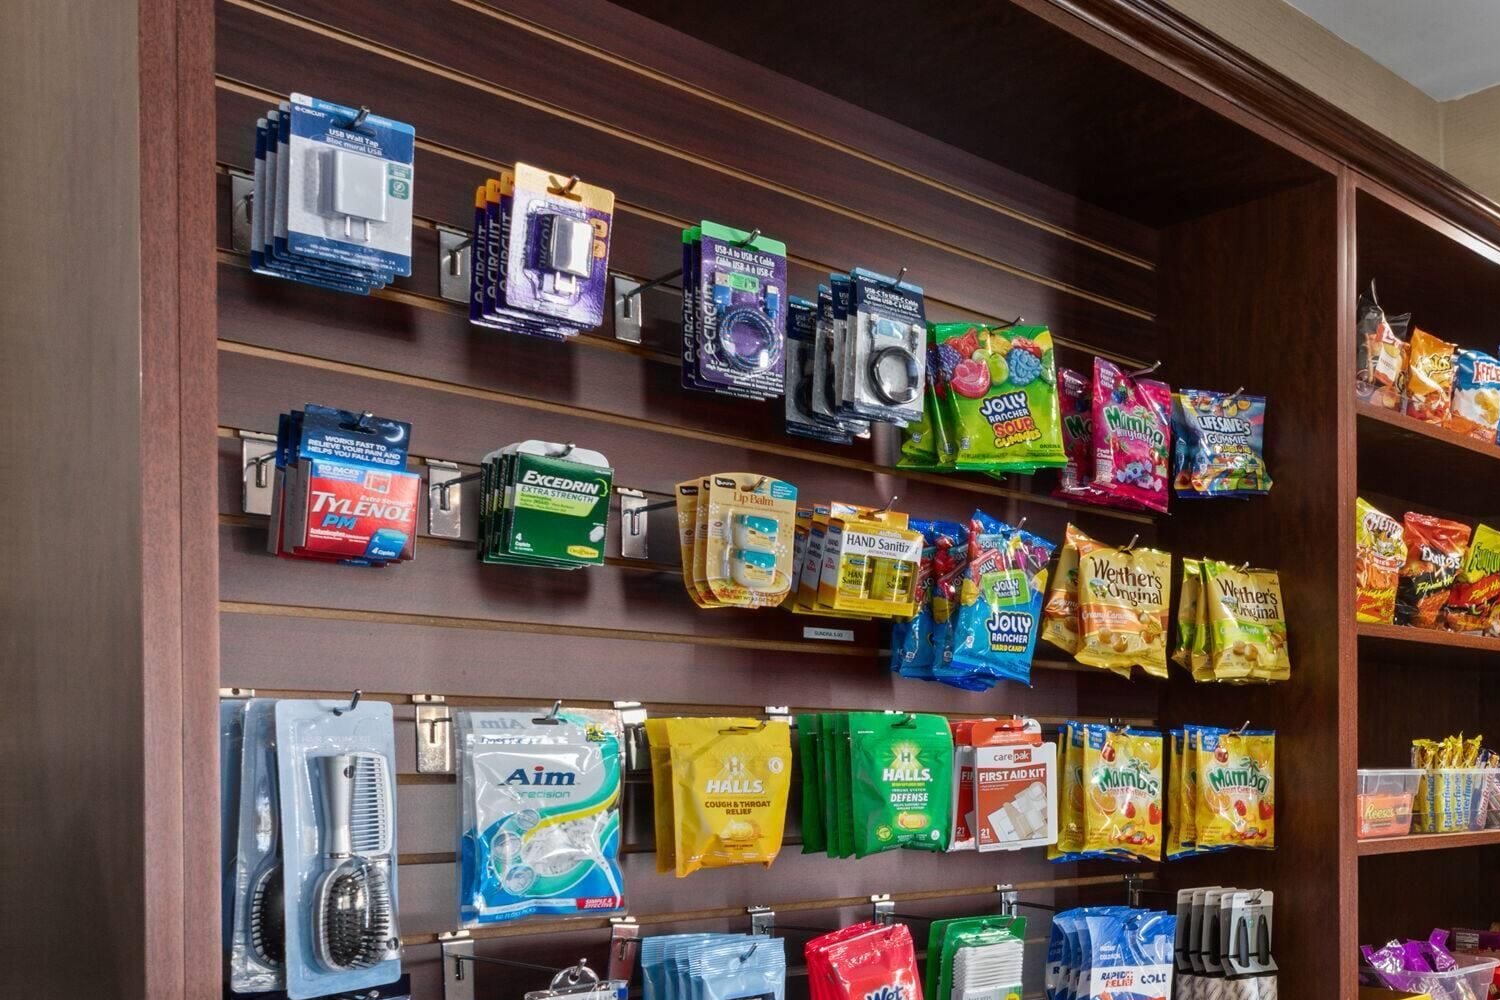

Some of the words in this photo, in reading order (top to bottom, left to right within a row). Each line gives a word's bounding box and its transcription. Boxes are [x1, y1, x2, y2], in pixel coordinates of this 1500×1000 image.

[329, 129, 344, 138] USB
[346, 133, 363, 143] Wall
[366, 138, 379, 148] Tap
[714, 244, 733, 257] USB-A
[734, 250, 740, 258] to
[741, 251, 759, 264] USB-C
[760, 256, 775, 268] Cable
[982, 391, 1028, 417] JOLLY
[988, 408, 1030, 423] RANCHER
[993, 418, 1035, 438] SOUR
[1104, 406, 1164, 446] Mamba
[325, 436, 355, 447] WORKS
[355, 441, 375, 450] FAST
[994, 430, 1042, 448] GUMMIES
[307, 438, 341, 451] RELIEVE
[341, 445, 364, 455] YOUR
[364, 448, 383, 457] PAIN
[383, 452, 401, 460] AND
[307, 446, 333, 456] HELPS
[334, 450, 351, 459] YOU
[352, 454, 371, 462] FALL
[372, 456, 401, 466] ASLEEP
[333, 466, 360, 476] PACKS
[522, 469, 600, 495] EXCEDRIN
[521, 485, 550, 496] EXTRA
[550, 490, 594, 503] STRENGTH
[733, 491, 749, 506] Lip
[750, 494, 774, 508] Balm
[311, 490, 412, 522] TYLENOL
[322, 513, 358, 530] PM
[515, 532, 522, 541] 4
[846, 533, 876, 549] HAND
[371, 547, 378, 555] 4
[1422, 543, 1461, 569] Doritos
[1090, 556, 1162, 590] Werther's
[993, 579, 1019, 593] JOLLY
[1107, 583, 1162, 607] Original
[988, 612, 1031, 634] JOLLY
[991, 633, 1028, 644] RANCHER
[991, 643, 1008, 652] HARD
[1008, 645, 1027, 653] CANDY
[499, 765, 576, 787] Aim
[729, 760, 740, 775] H
[979, 770, 1009, 782] FIRST
[1009, 769, 1028, 780] AID
[1029, 767, 1046, 779] KIT
[1098, 766, 1159, 796] Mamba
[1210, 768, 1268, 795] Mamba
[704, 801, 732, 809] COUGH
[733, 801, 738, 809] &
[739, 800, 771, 809] THROAT
[890, 792, 929, 803] DEFENSE
[726, 807, 753, 816] RELIEF
[981, 828, 990, 837] 21
[1101, 971, 1126, 981] RAPID
